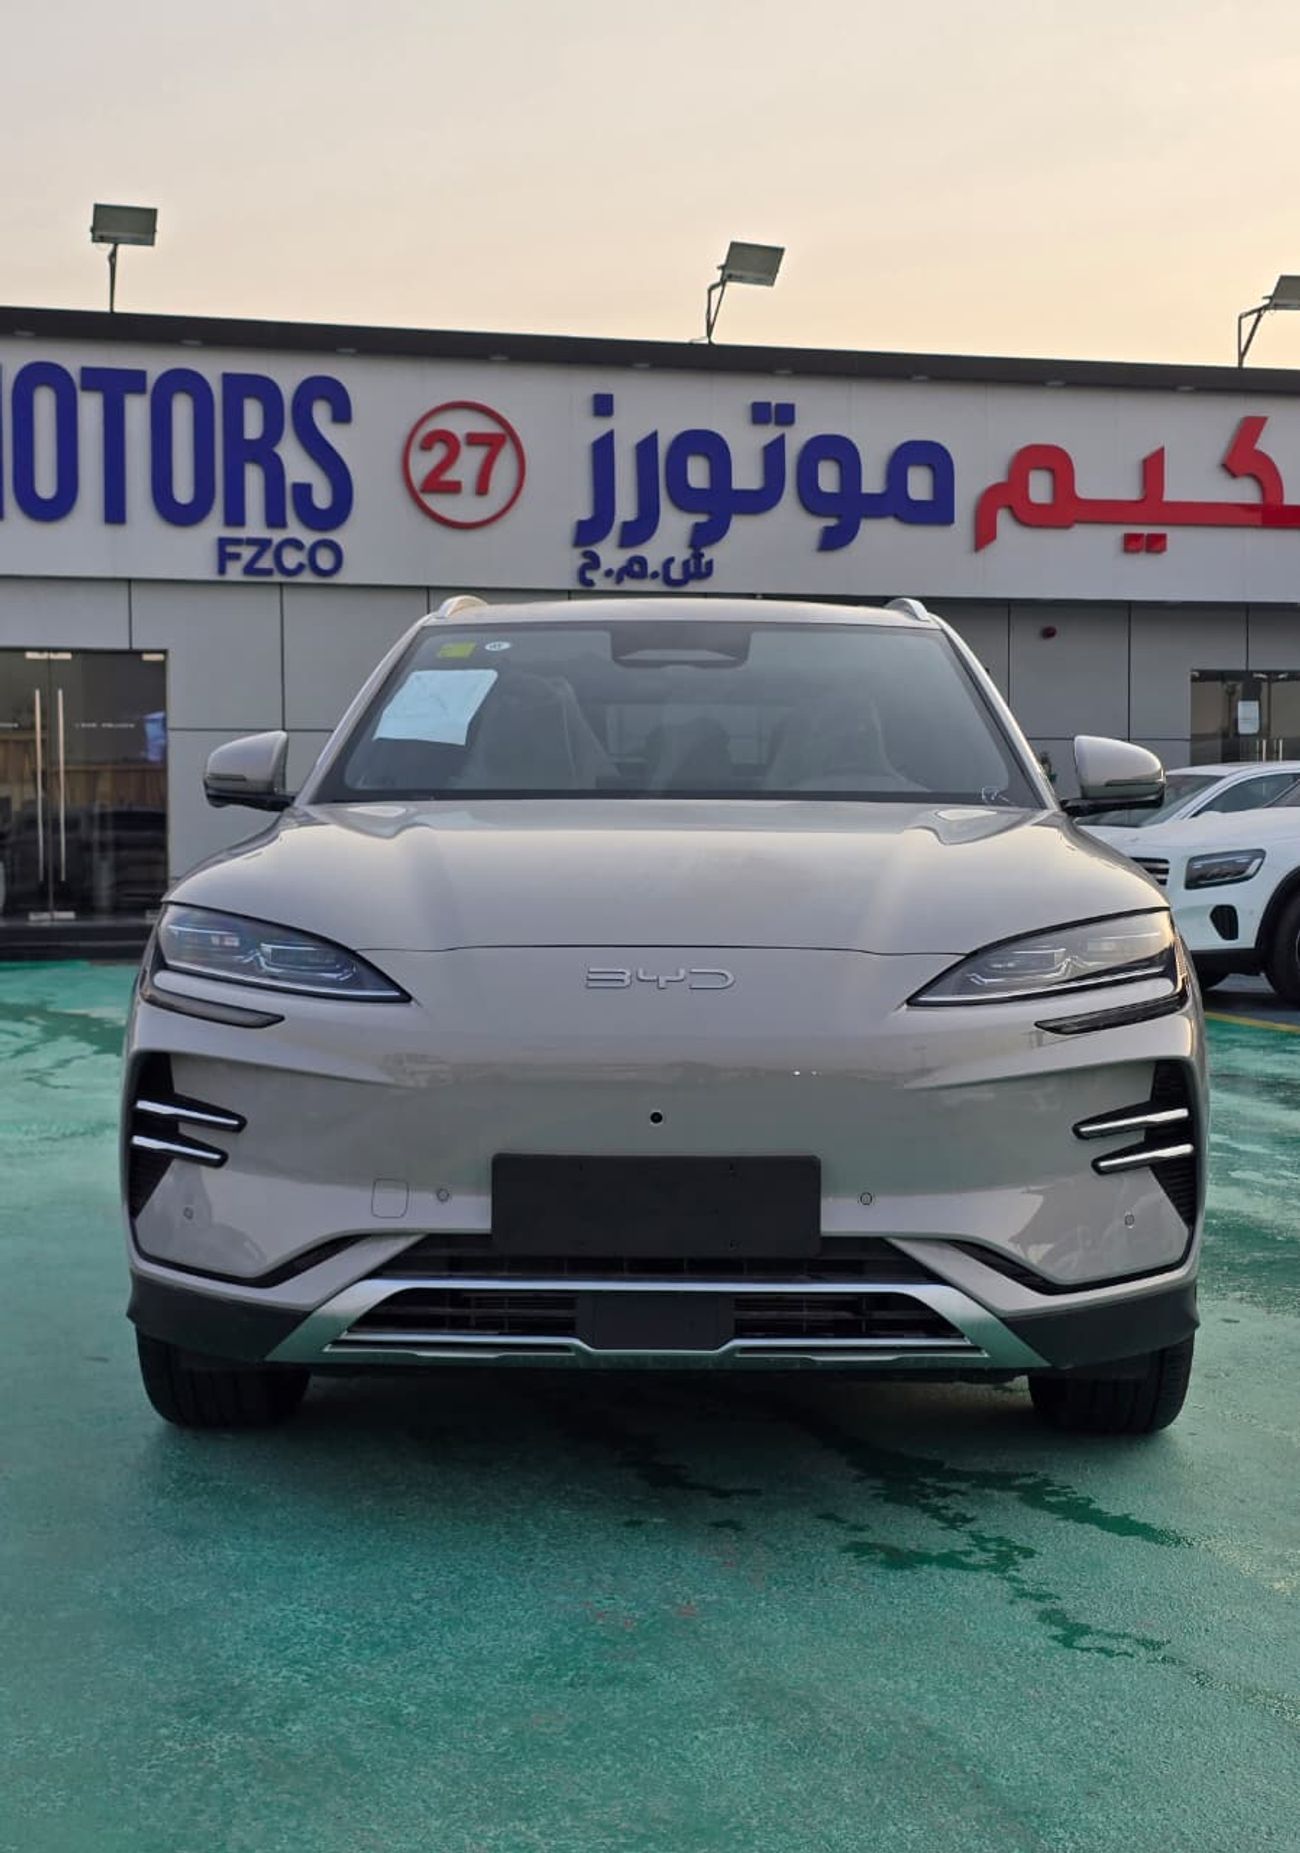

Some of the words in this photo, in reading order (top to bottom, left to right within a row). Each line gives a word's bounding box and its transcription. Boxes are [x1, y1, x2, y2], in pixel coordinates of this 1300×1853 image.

[0, 360, 355, 531] OTORS
[418, 429, 507, 496] 27
[574, 393, 957, 552] موتورز
[974, 416, 1300, 554] كيم
[217, 537, 344, 577] FZCO
[585, 967, 736, 990] BYD
